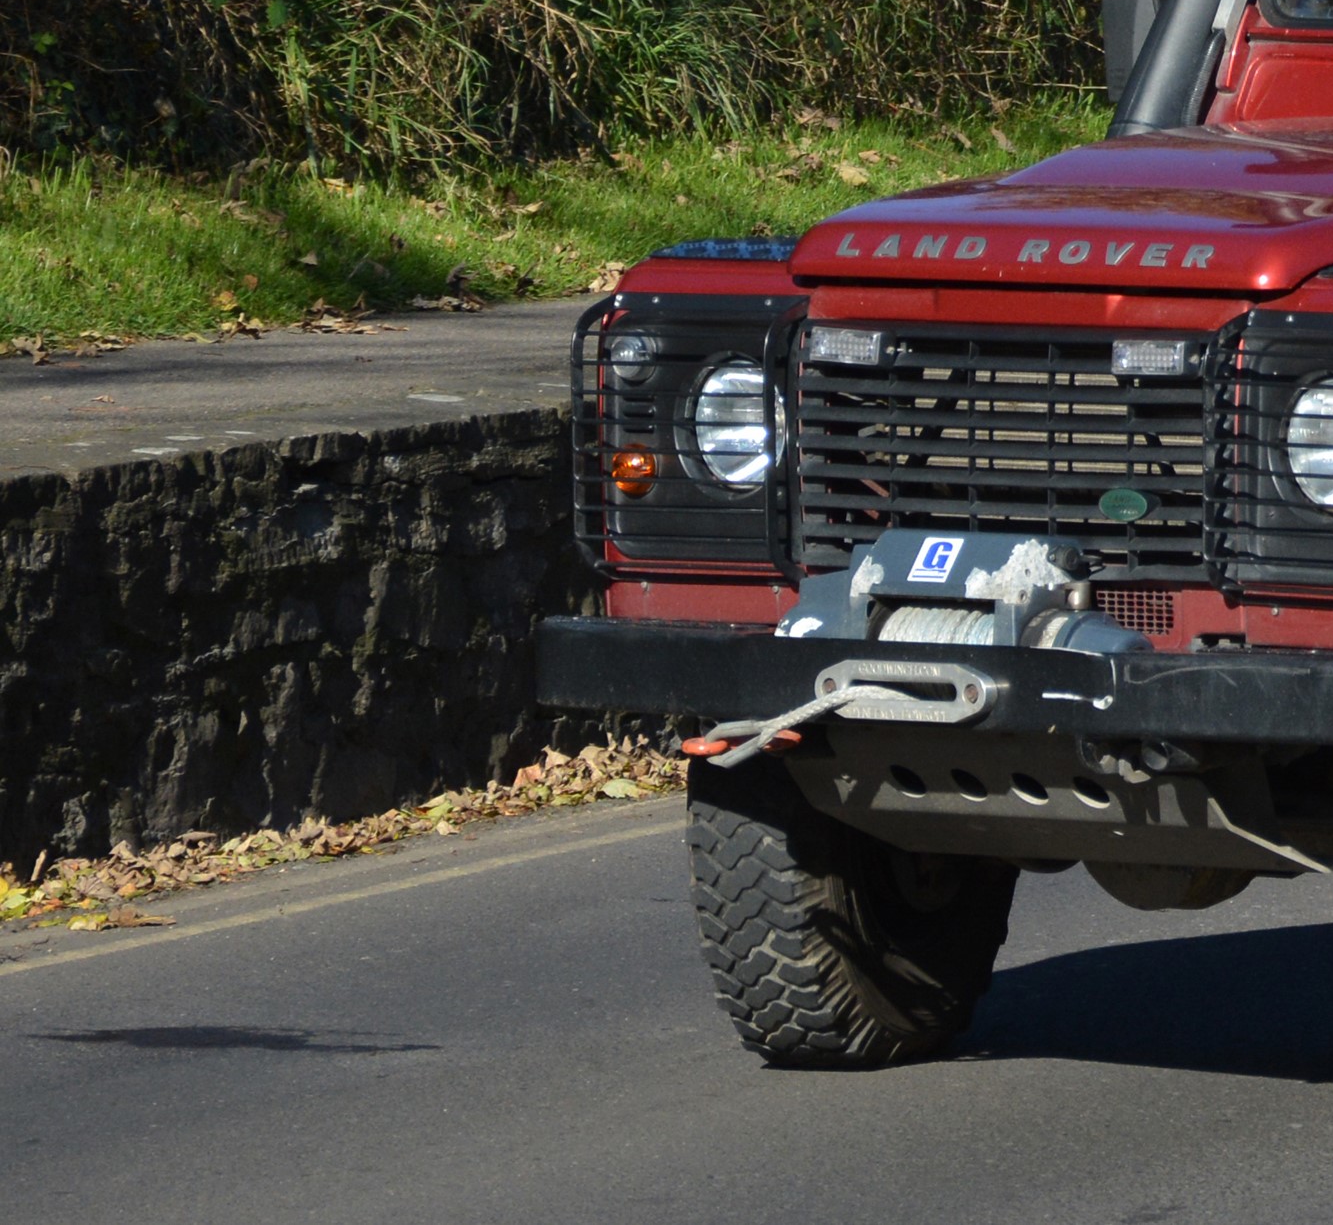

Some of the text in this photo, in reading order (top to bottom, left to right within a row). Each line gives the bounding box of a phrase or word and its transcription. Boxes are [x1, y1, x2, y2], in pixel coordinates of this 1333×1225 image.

[835, 233, 1215, 269] LAND ROVER
[922, 541, 953, 569] G
